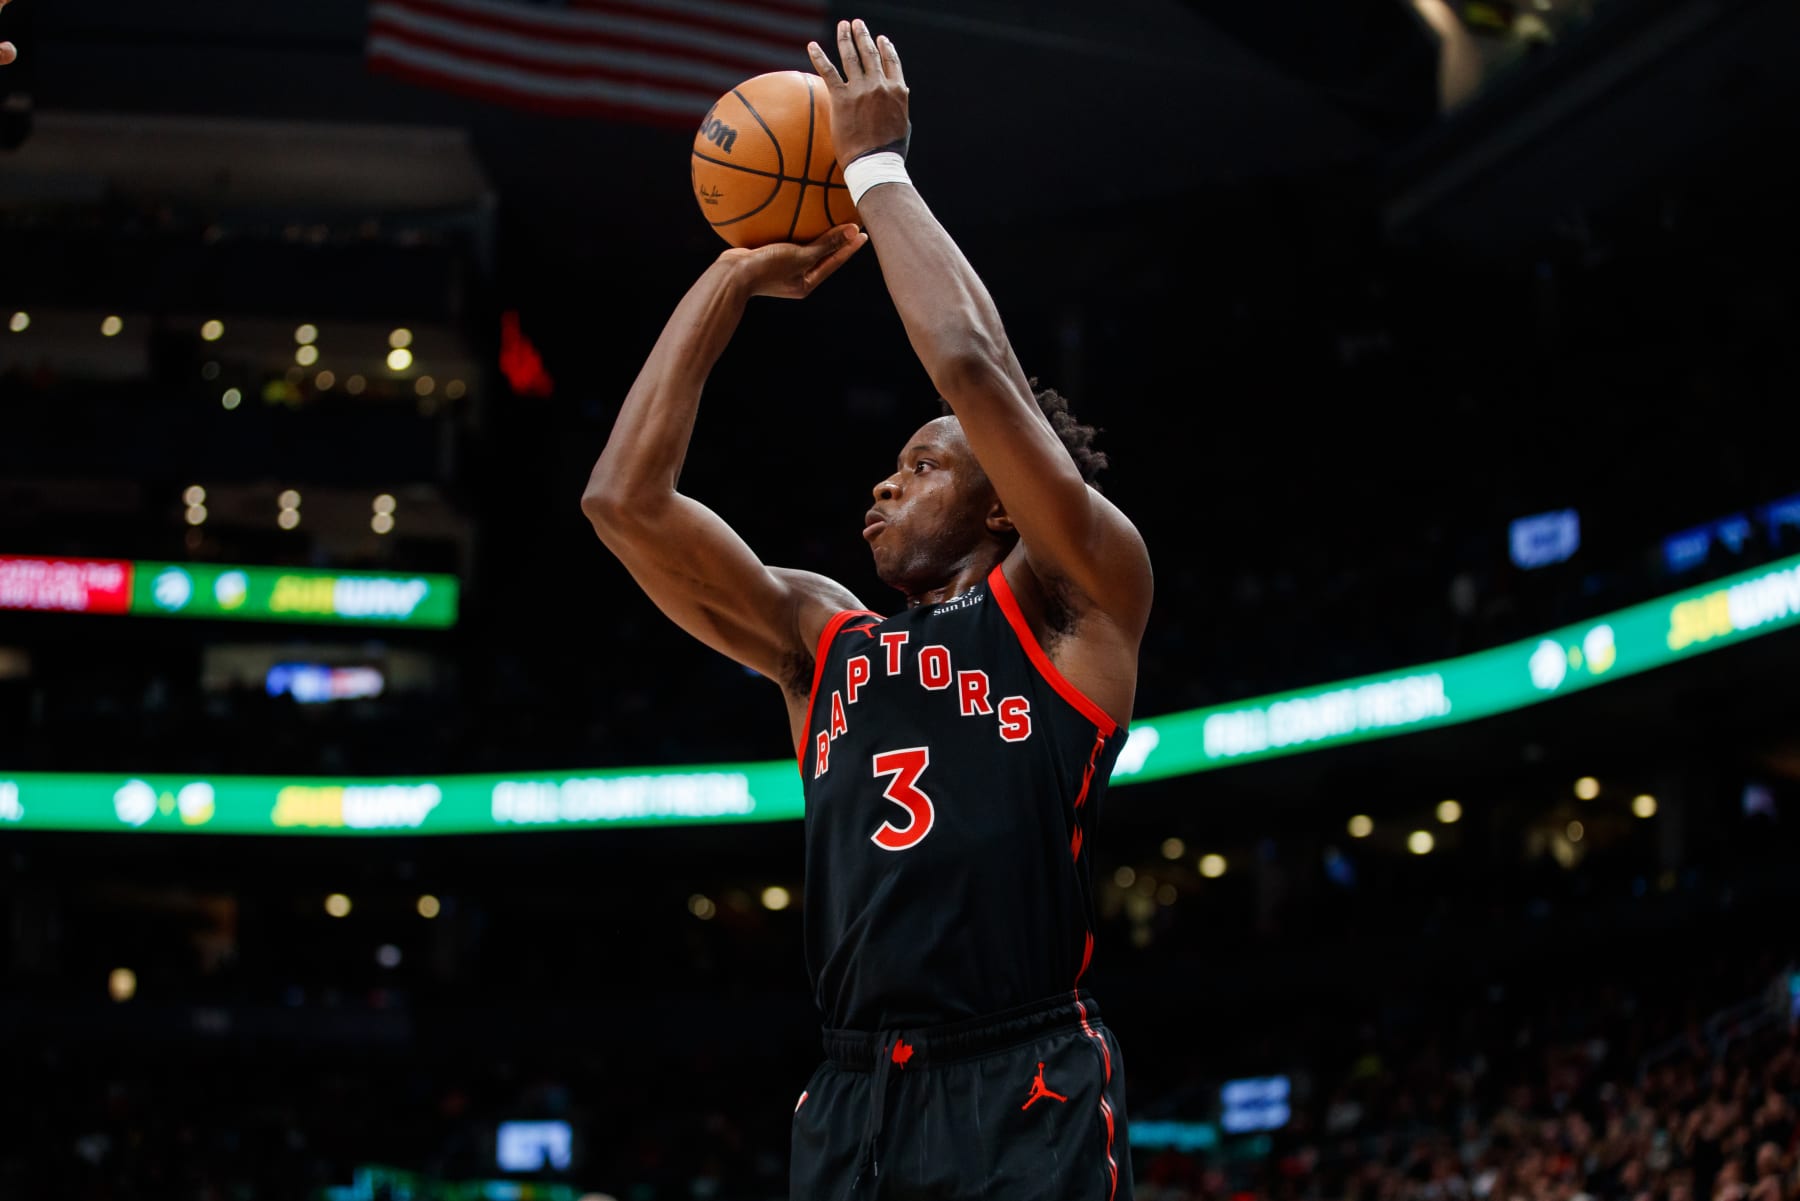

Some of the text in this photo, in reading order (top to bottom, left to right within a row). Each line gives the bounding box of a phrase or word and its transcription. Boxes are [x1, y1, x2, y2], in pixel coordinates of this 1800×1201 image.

[933, 594, 984, 617] Sun Life
[814, 630, 1033, 780] RAPTORS
[870, 746, 936, 851] 3
